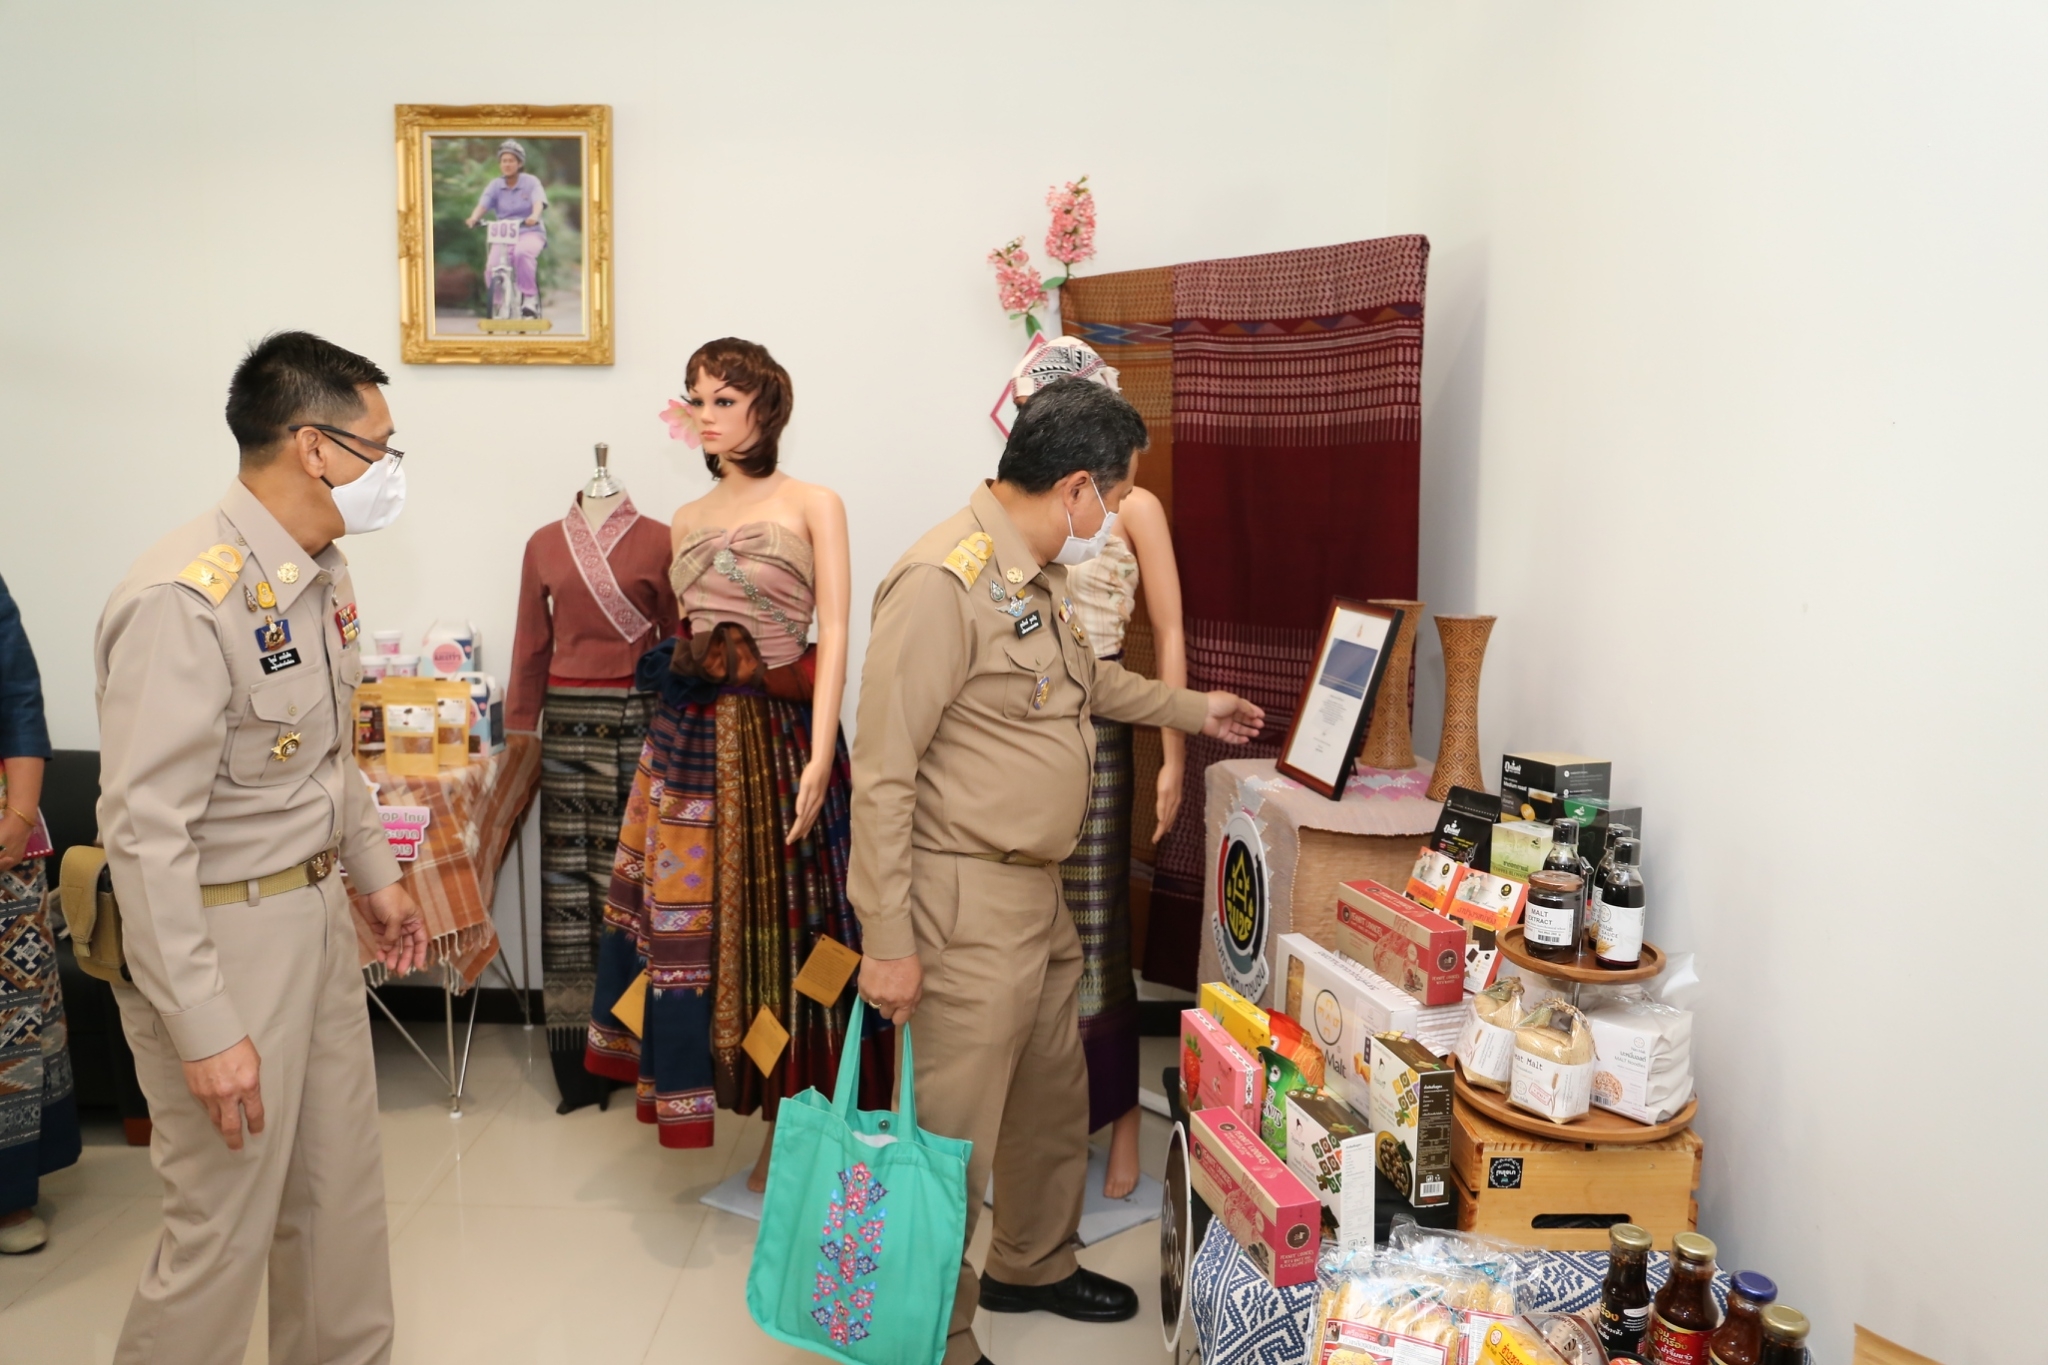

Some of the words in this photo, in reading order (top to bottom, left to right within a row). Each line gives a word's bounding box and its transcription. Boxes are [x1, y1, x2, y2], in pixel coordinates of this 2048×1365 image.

[1531, 908, 1548, 918] MALT
[1528, 914, 1552, 925] EXTRACT
[1325, 1048, 1347, 1080] Malt
[1526, 1057, 1543, 1071] Malt
